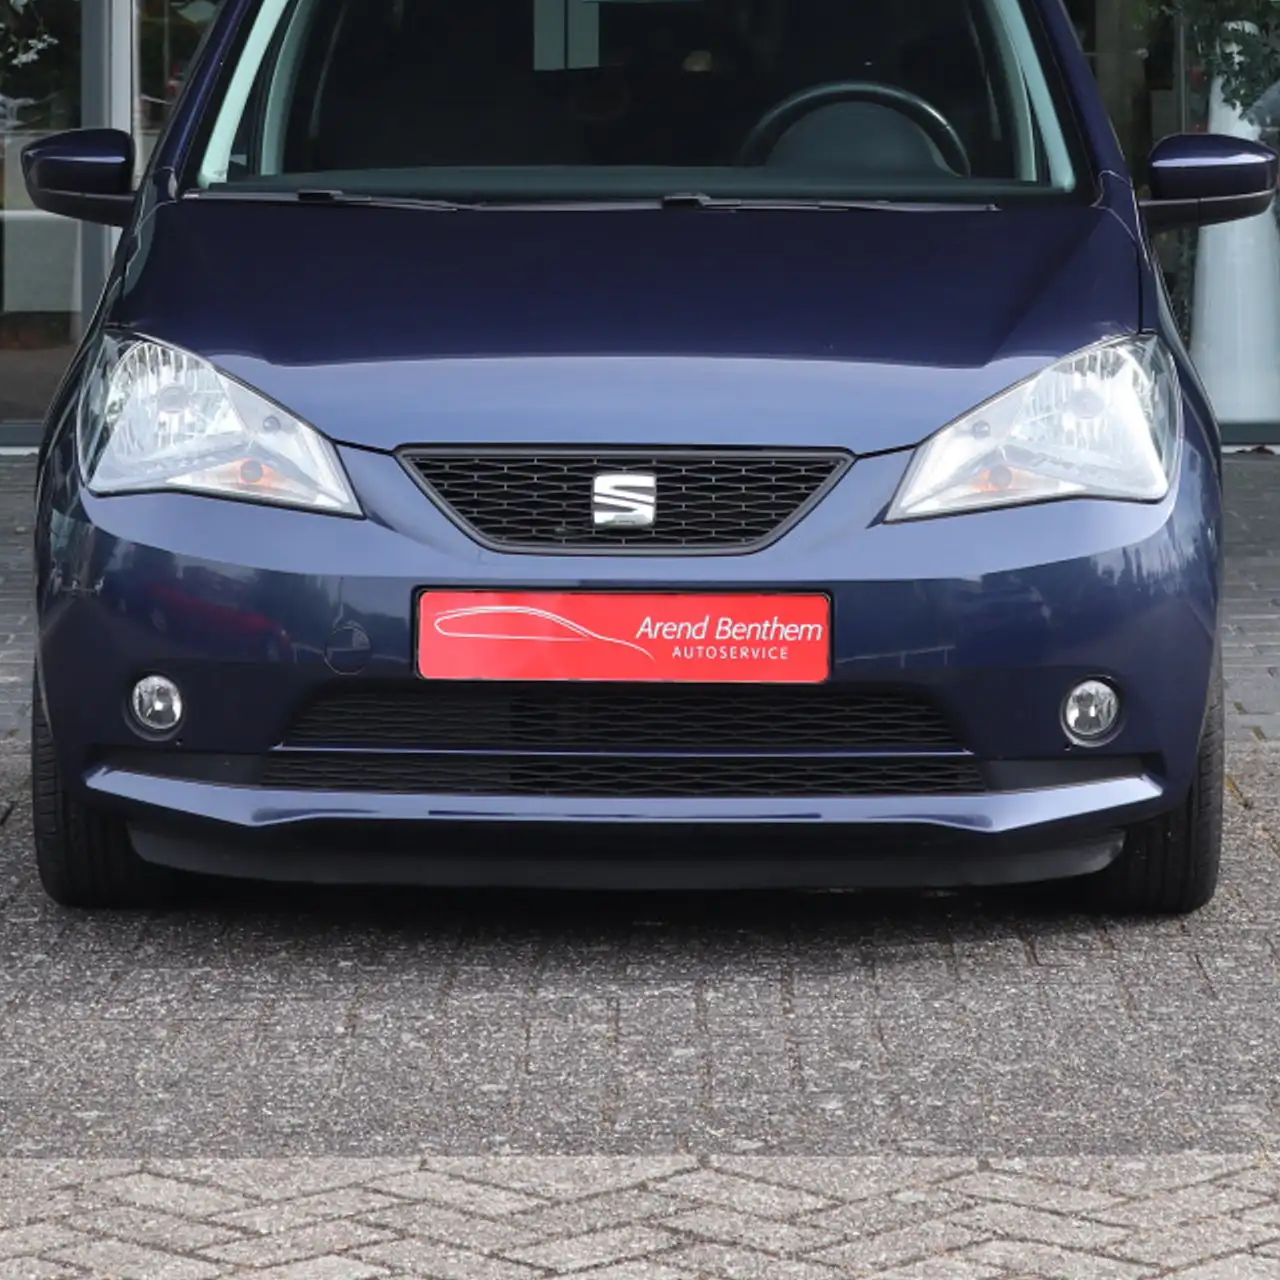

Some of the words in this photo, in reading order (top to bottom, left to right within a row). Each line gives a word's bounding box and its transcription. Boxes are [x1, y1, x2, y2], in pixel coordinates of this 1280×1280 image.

[635, 615, 709, 640] Arend
[715, 616, 823, 642] Benthem
[672, 646, 789, 660] AUTOSERVICE
